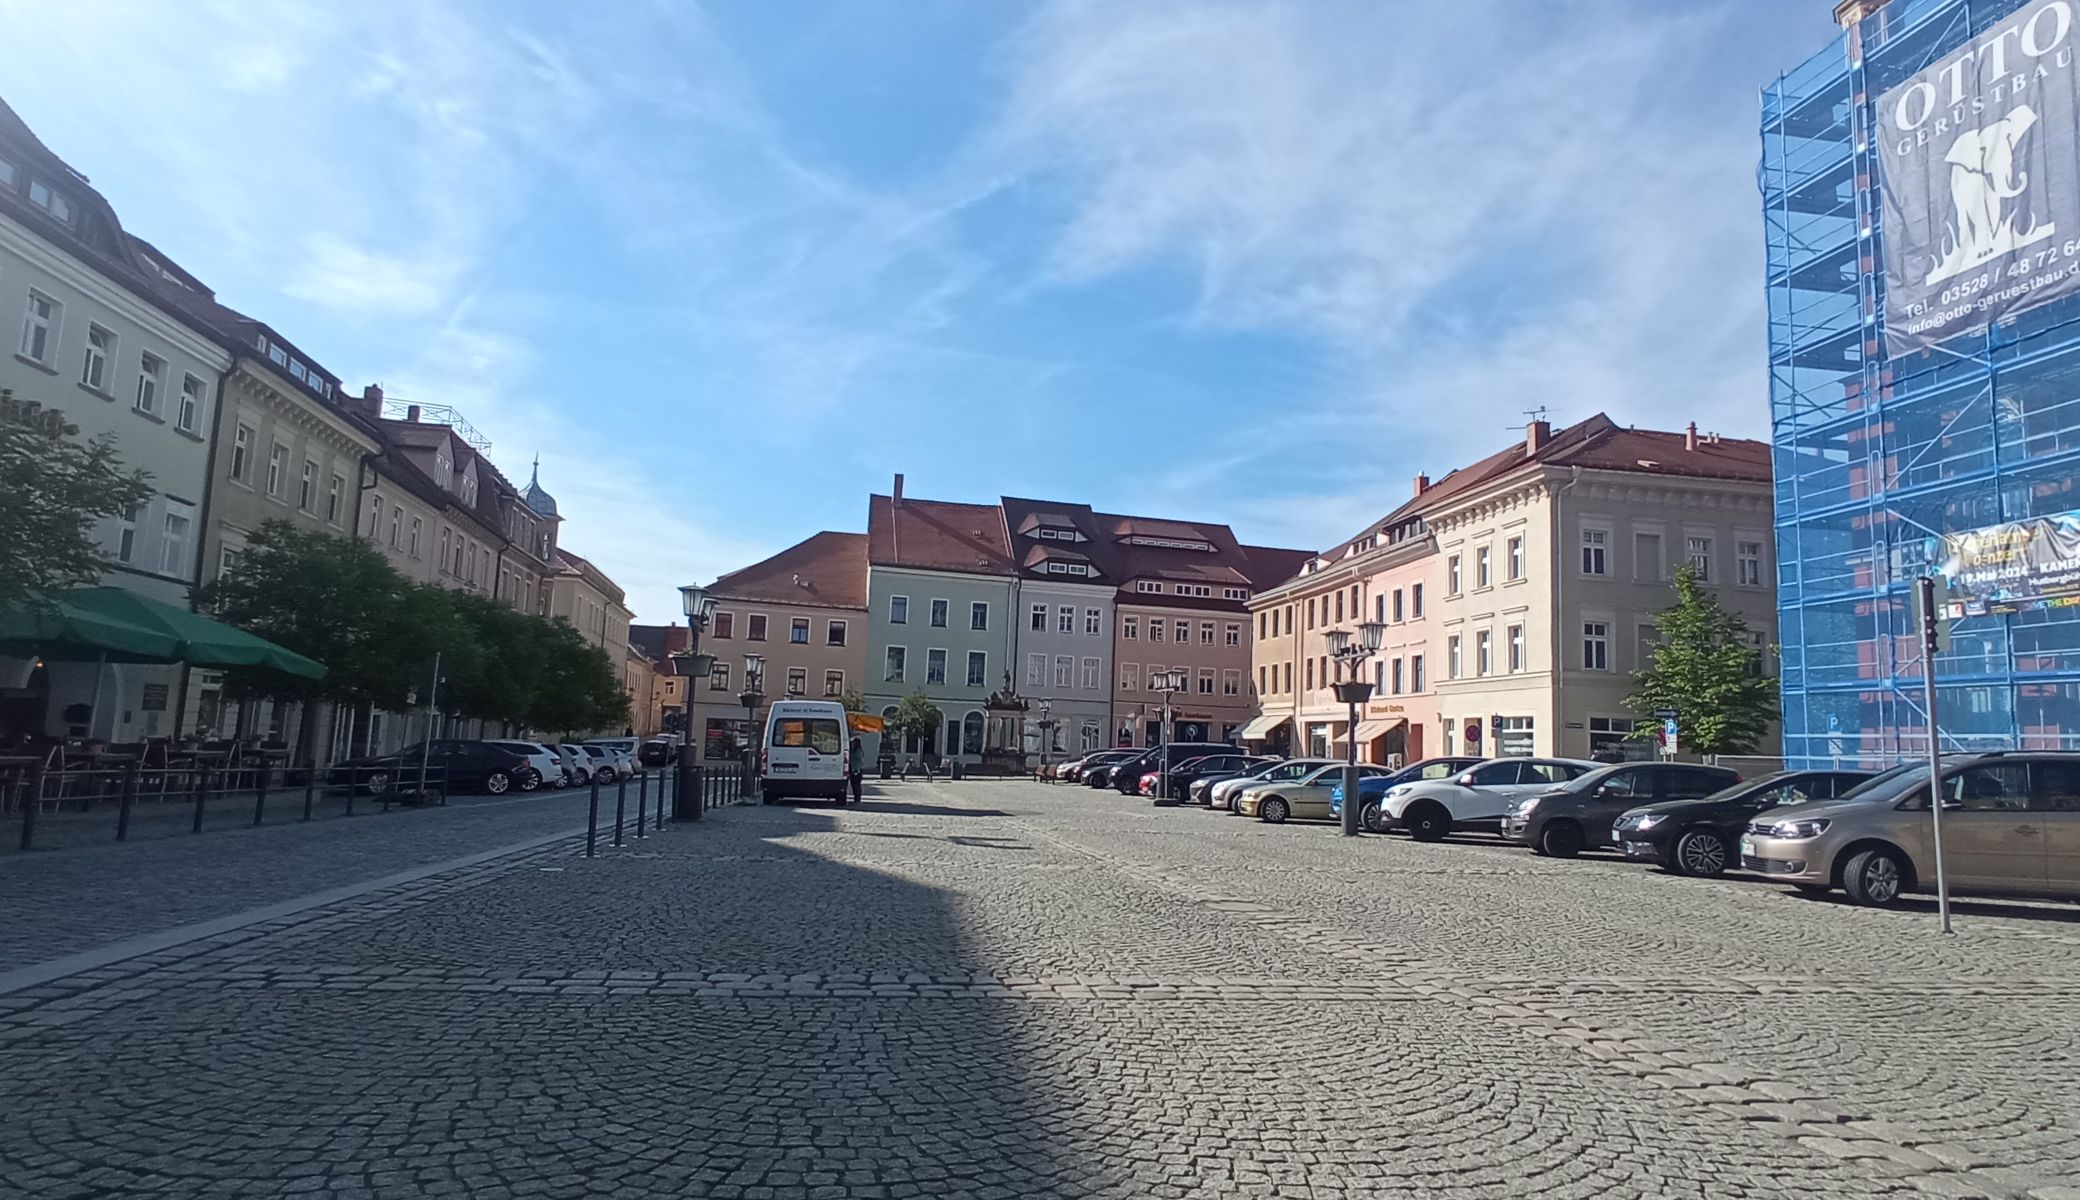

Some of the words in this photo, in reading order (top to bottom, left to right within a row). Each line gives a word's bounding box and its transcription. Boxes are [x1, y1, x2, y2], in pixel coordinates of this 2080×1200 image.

[1895, 1, 2072, 131] OTTO
[1897, 47, 2072, 156] GERÜSTBAU
[1905, 298, 1934, 319] Tel.
[1941, 273, 1988, 305] 03528
[1994, 267, 2000, 284] /
[2007, 258, 2030, 278] 48
[2035, 247, 2058, 268] 72
